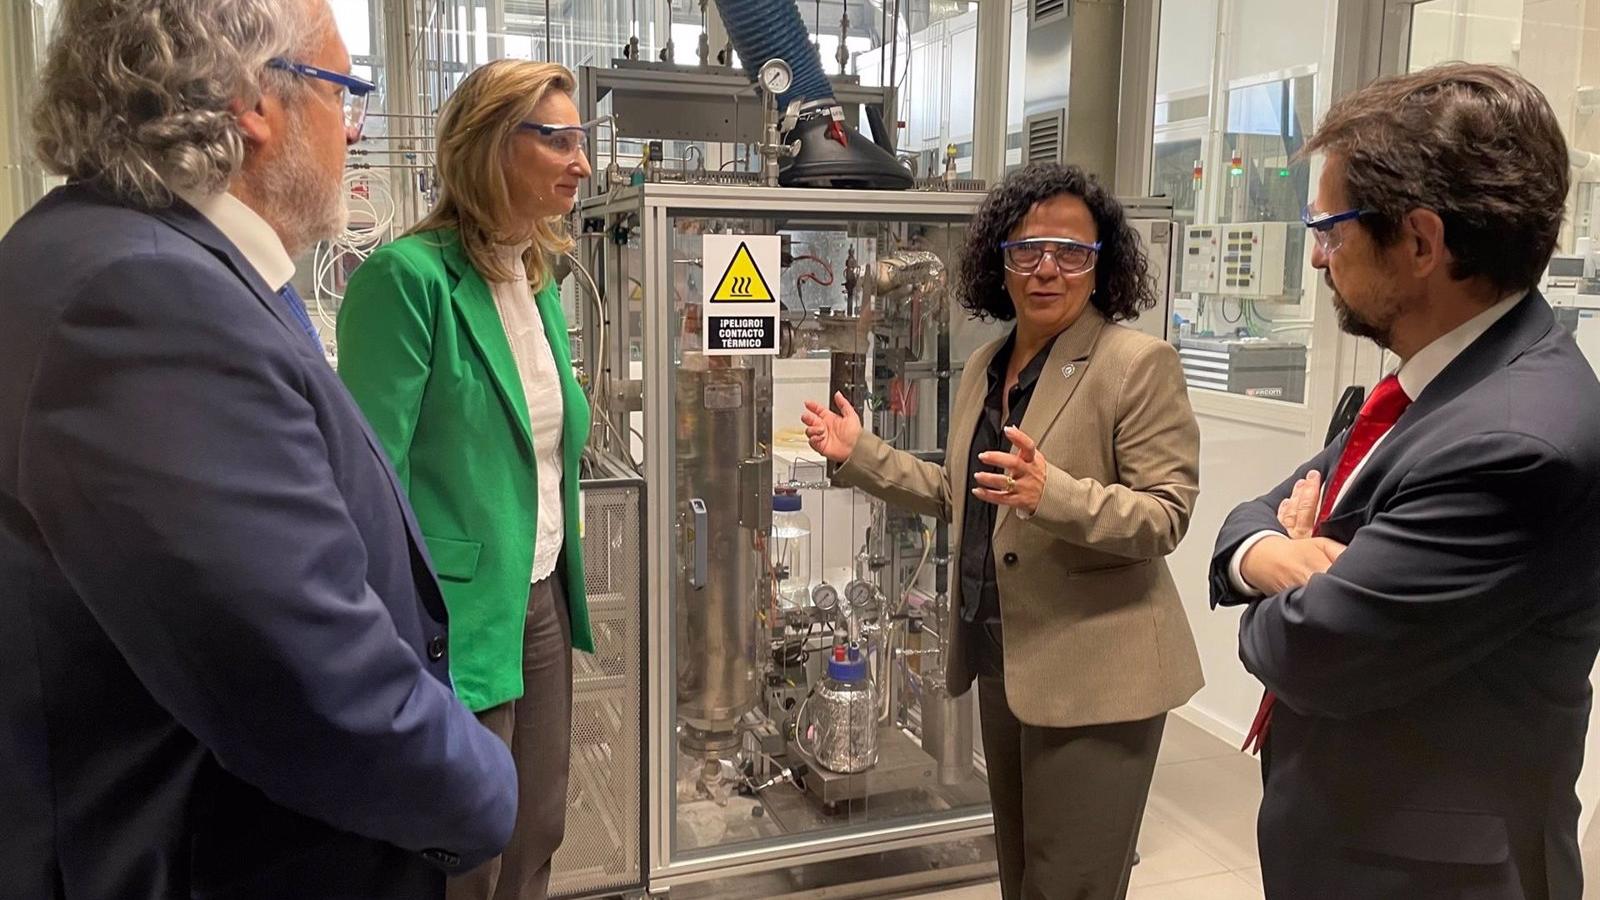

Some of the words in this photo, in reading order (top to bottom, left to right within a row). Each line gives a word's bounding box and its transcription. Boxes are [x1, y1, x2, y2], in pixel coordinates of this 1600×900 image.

[720, 319, 764, 328] ¡PELIGRO!
[719, 329, 765, 338] CONTACTO
[721, 337, 762, 348] TÉRMICO
